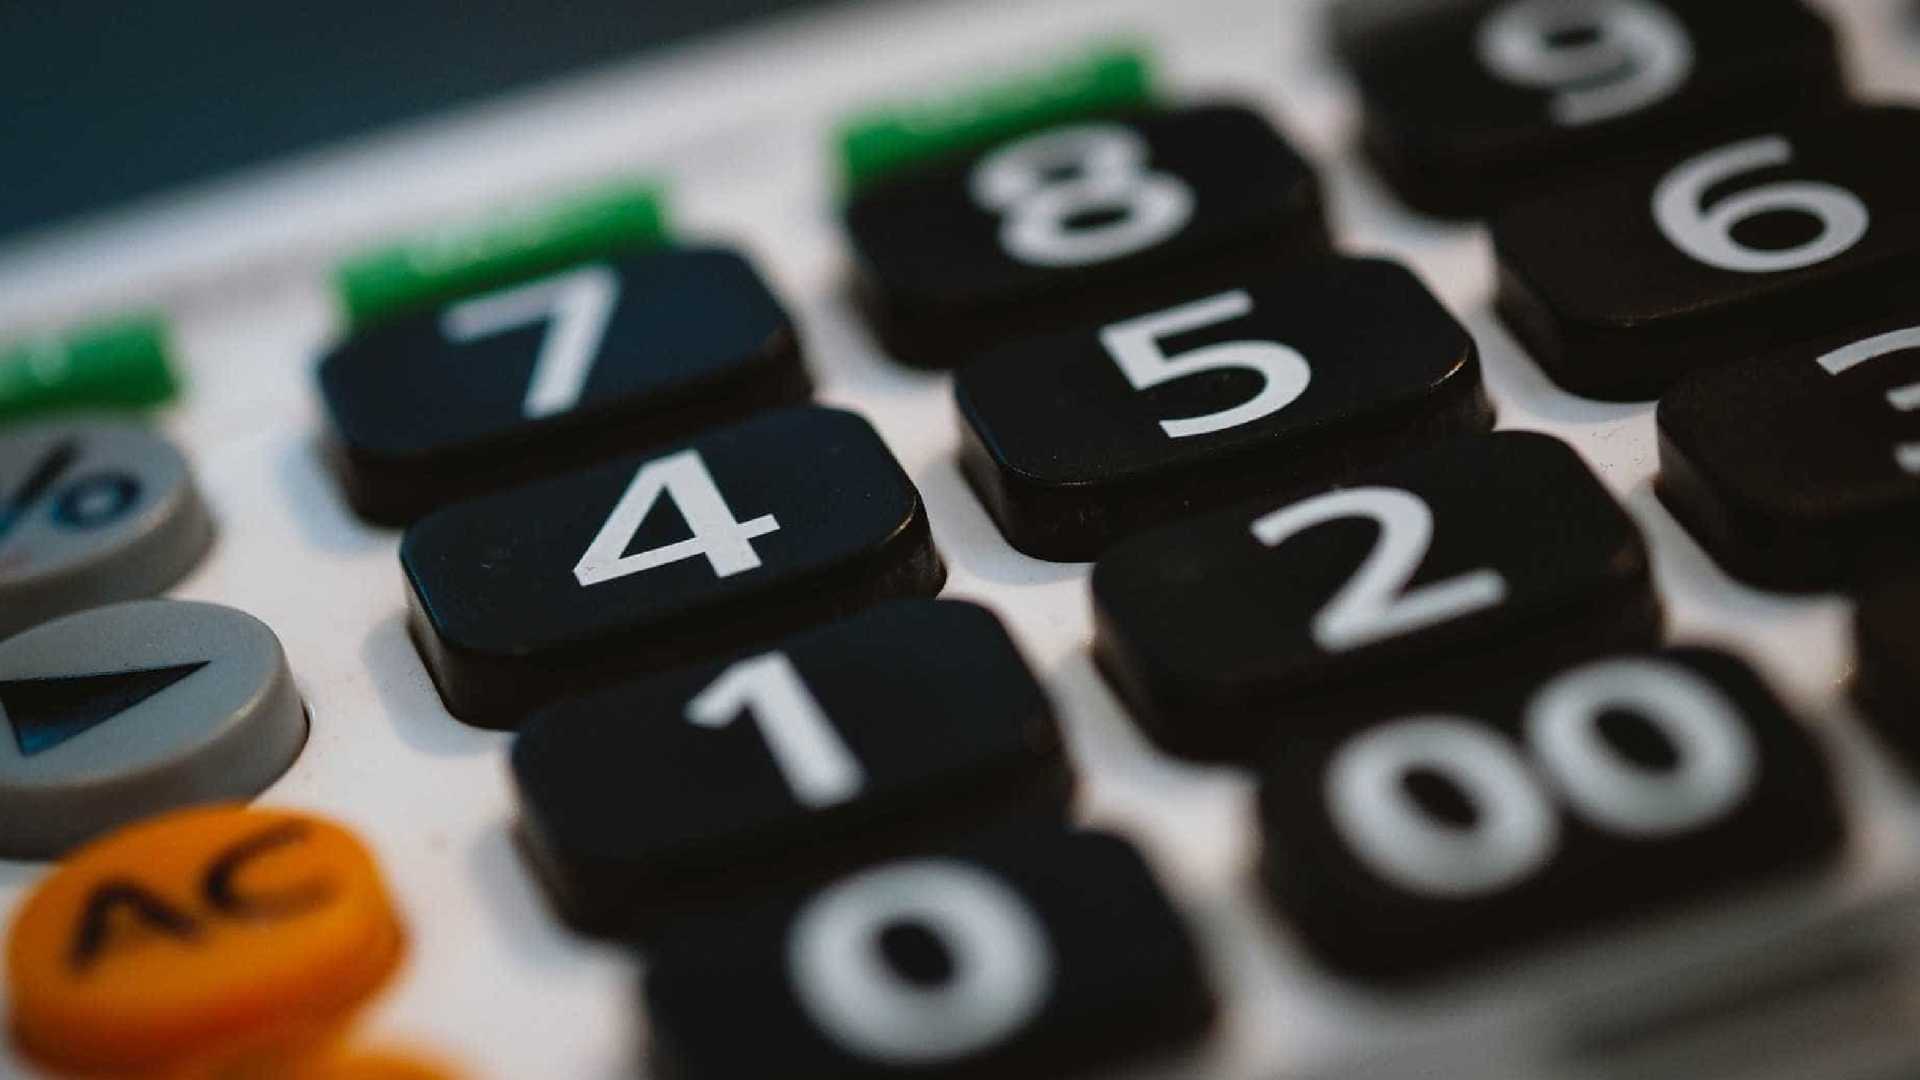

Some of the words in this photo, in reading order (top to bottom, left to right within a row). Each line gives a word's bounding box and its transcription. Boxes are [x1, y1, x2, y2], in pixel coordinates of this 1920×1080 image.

[1479, 0, 1692, 125] 9
[973, 125, 1194, 265] 8
[1652, 136, 1869, 272] 6
[442, 267, 618, 418] 7
[1101, 290, 1312, 438] 5
[573, 450, 780, 587] 4
[1251, 486, 1504, 650] 2
[685, 651, 865, 808] 1
[1326, 658, 1757, 897] 00
[70, 820, 336, 974] AC
[790, 860, 1051, 1061] 0
